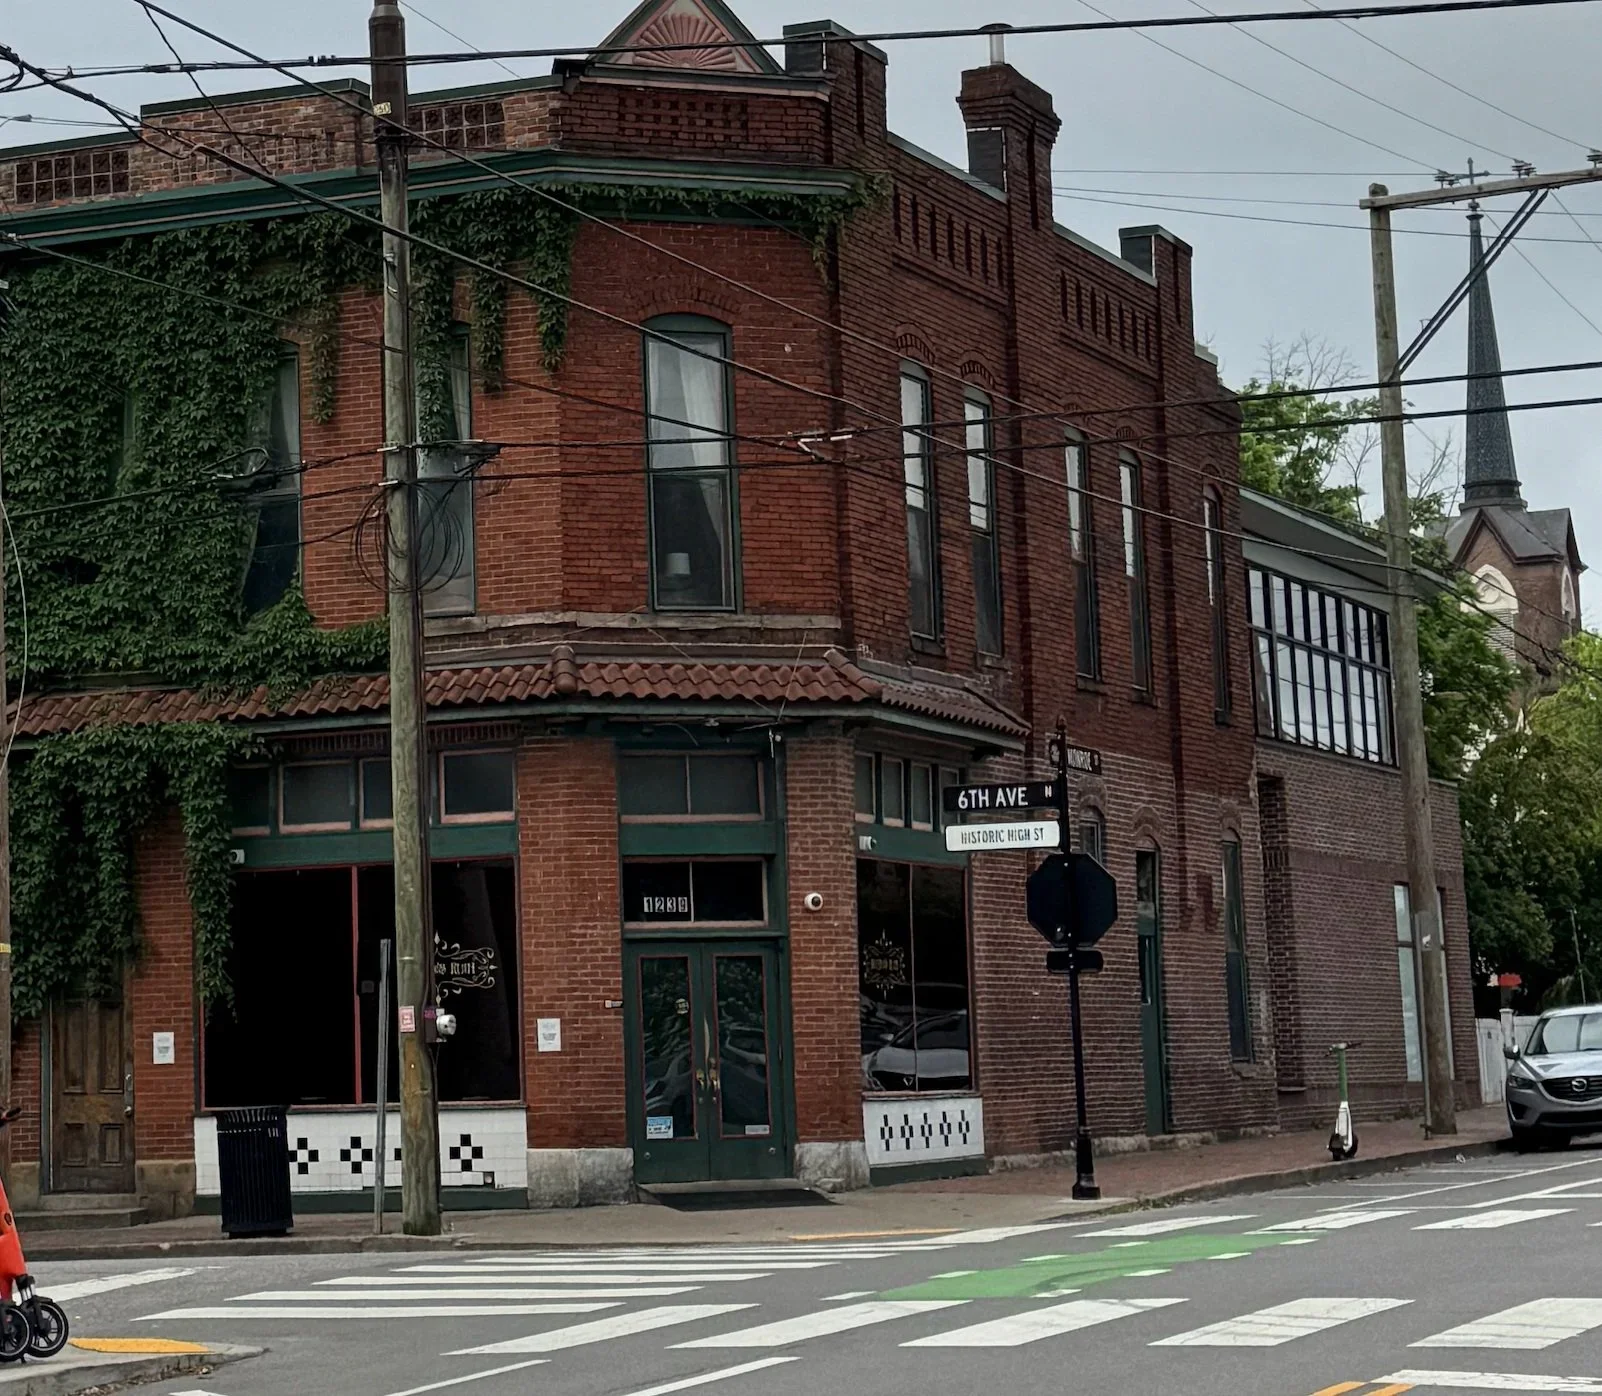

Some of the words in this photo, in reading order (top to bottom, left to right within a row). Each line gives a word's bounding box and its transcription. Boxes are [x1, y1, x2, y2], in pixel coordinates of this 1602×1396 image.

[958, 789, 989, 809] 6TH
[996, 787, 1028, 807] AVE
[1045, 785, 1052, 797] N
[961, 830, 1004, 844] HISTORIC
[1008, 829, 1030, 841] HIGH
[1034, 828, 1043, 840] ST
[644, 897, 688, 913] 1239
